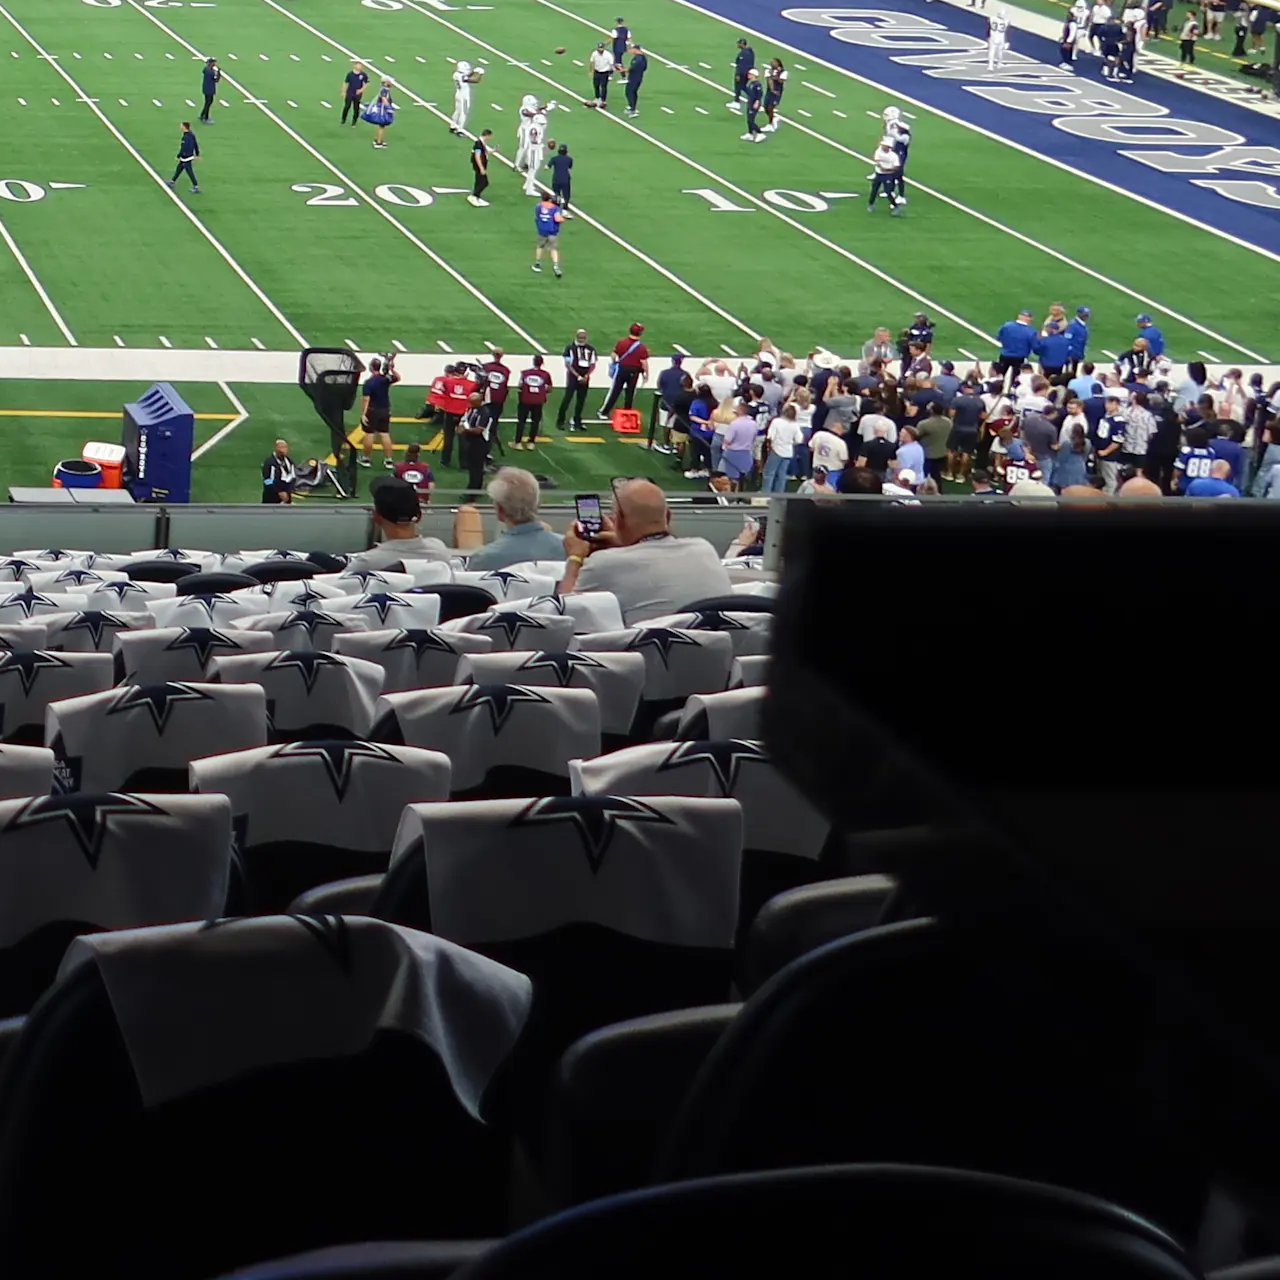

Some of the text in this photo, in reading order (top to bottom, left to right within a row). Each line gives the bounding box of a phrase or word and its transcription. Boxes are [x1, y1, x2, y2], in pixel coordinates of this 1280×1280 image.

[290, 183, 433, 207] 20
[680, 188, 829, 212] 10
[1006, 465, 1029, 484] 89
[1187, 457, 1212, 478] 88
